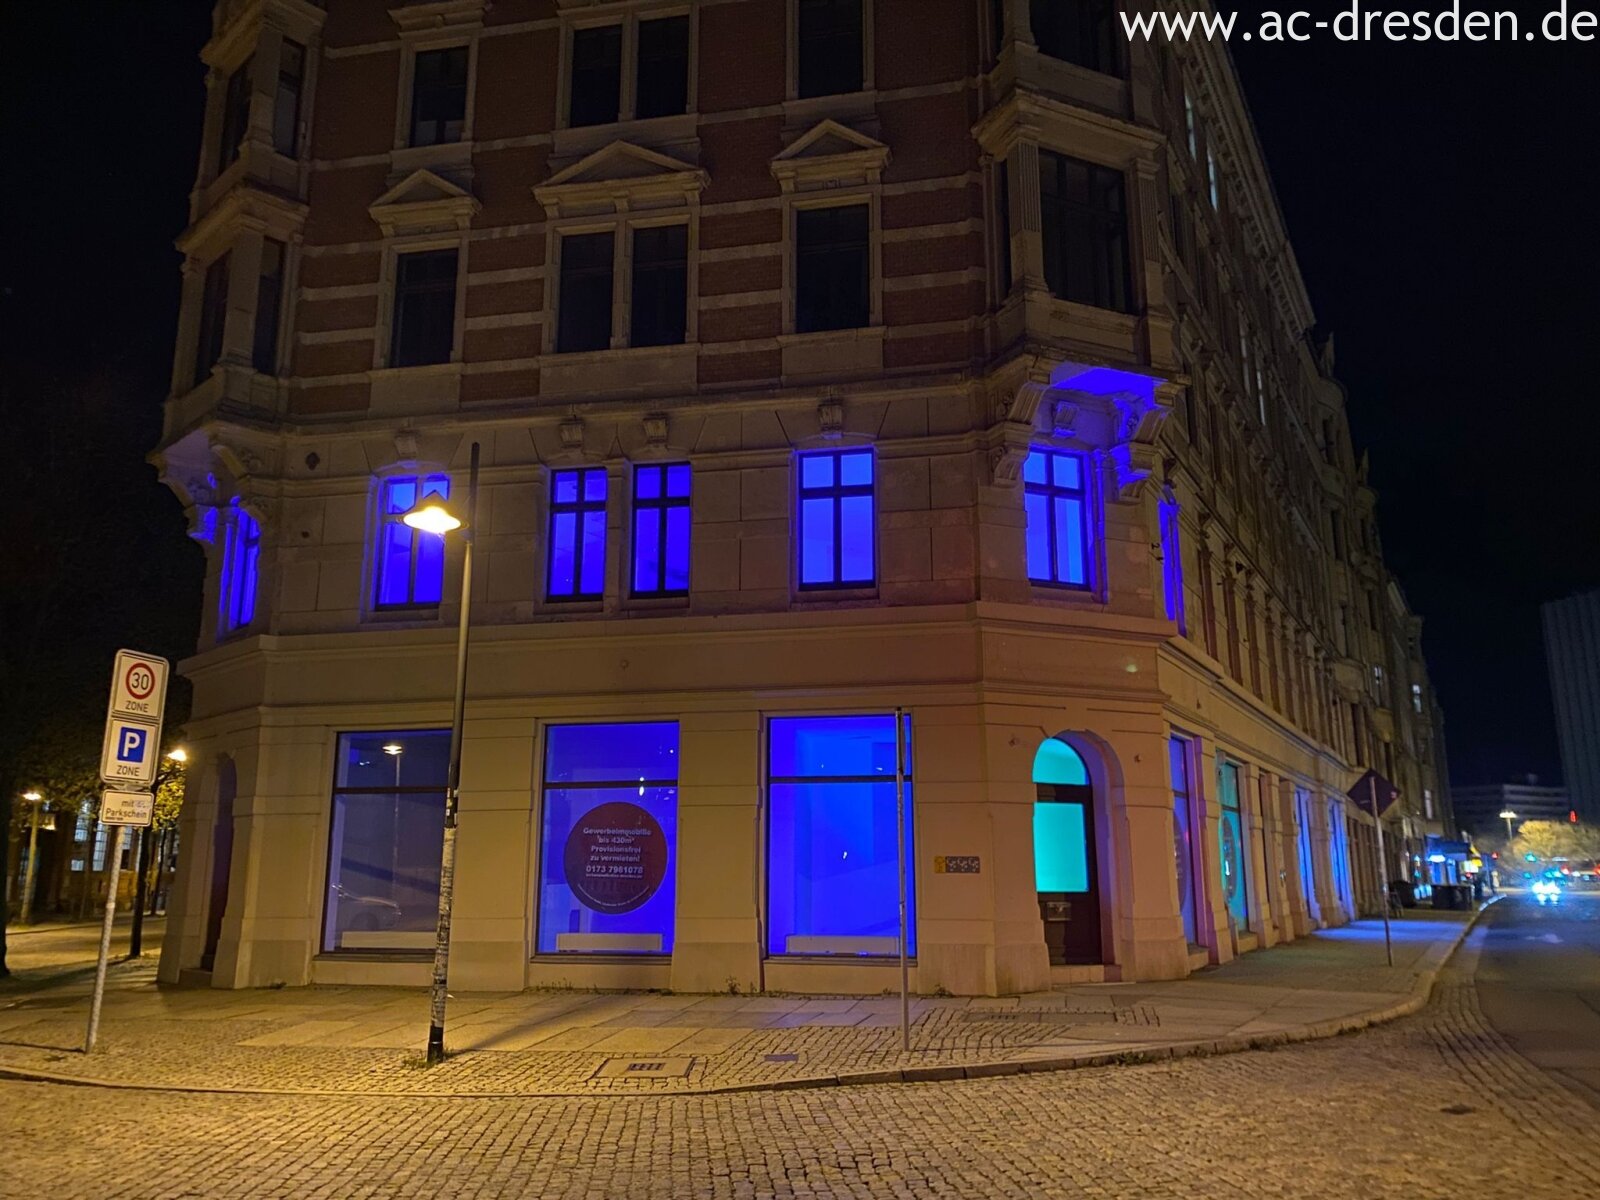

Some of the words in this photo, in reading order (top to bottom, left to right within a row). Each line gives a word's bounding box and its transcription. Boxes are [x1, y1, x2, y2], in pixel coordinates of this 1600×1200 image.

[131, 672, 150, 690] 30
[125, 700, 149, 713] ZONE
[122, 731, 141, 757] P
[116, 765, 140, 777] ZONE
[121, 799, 134, 808] mit
[105, 807, 147, 818] Parkschein
[585, 865, 607, 873] 0173
